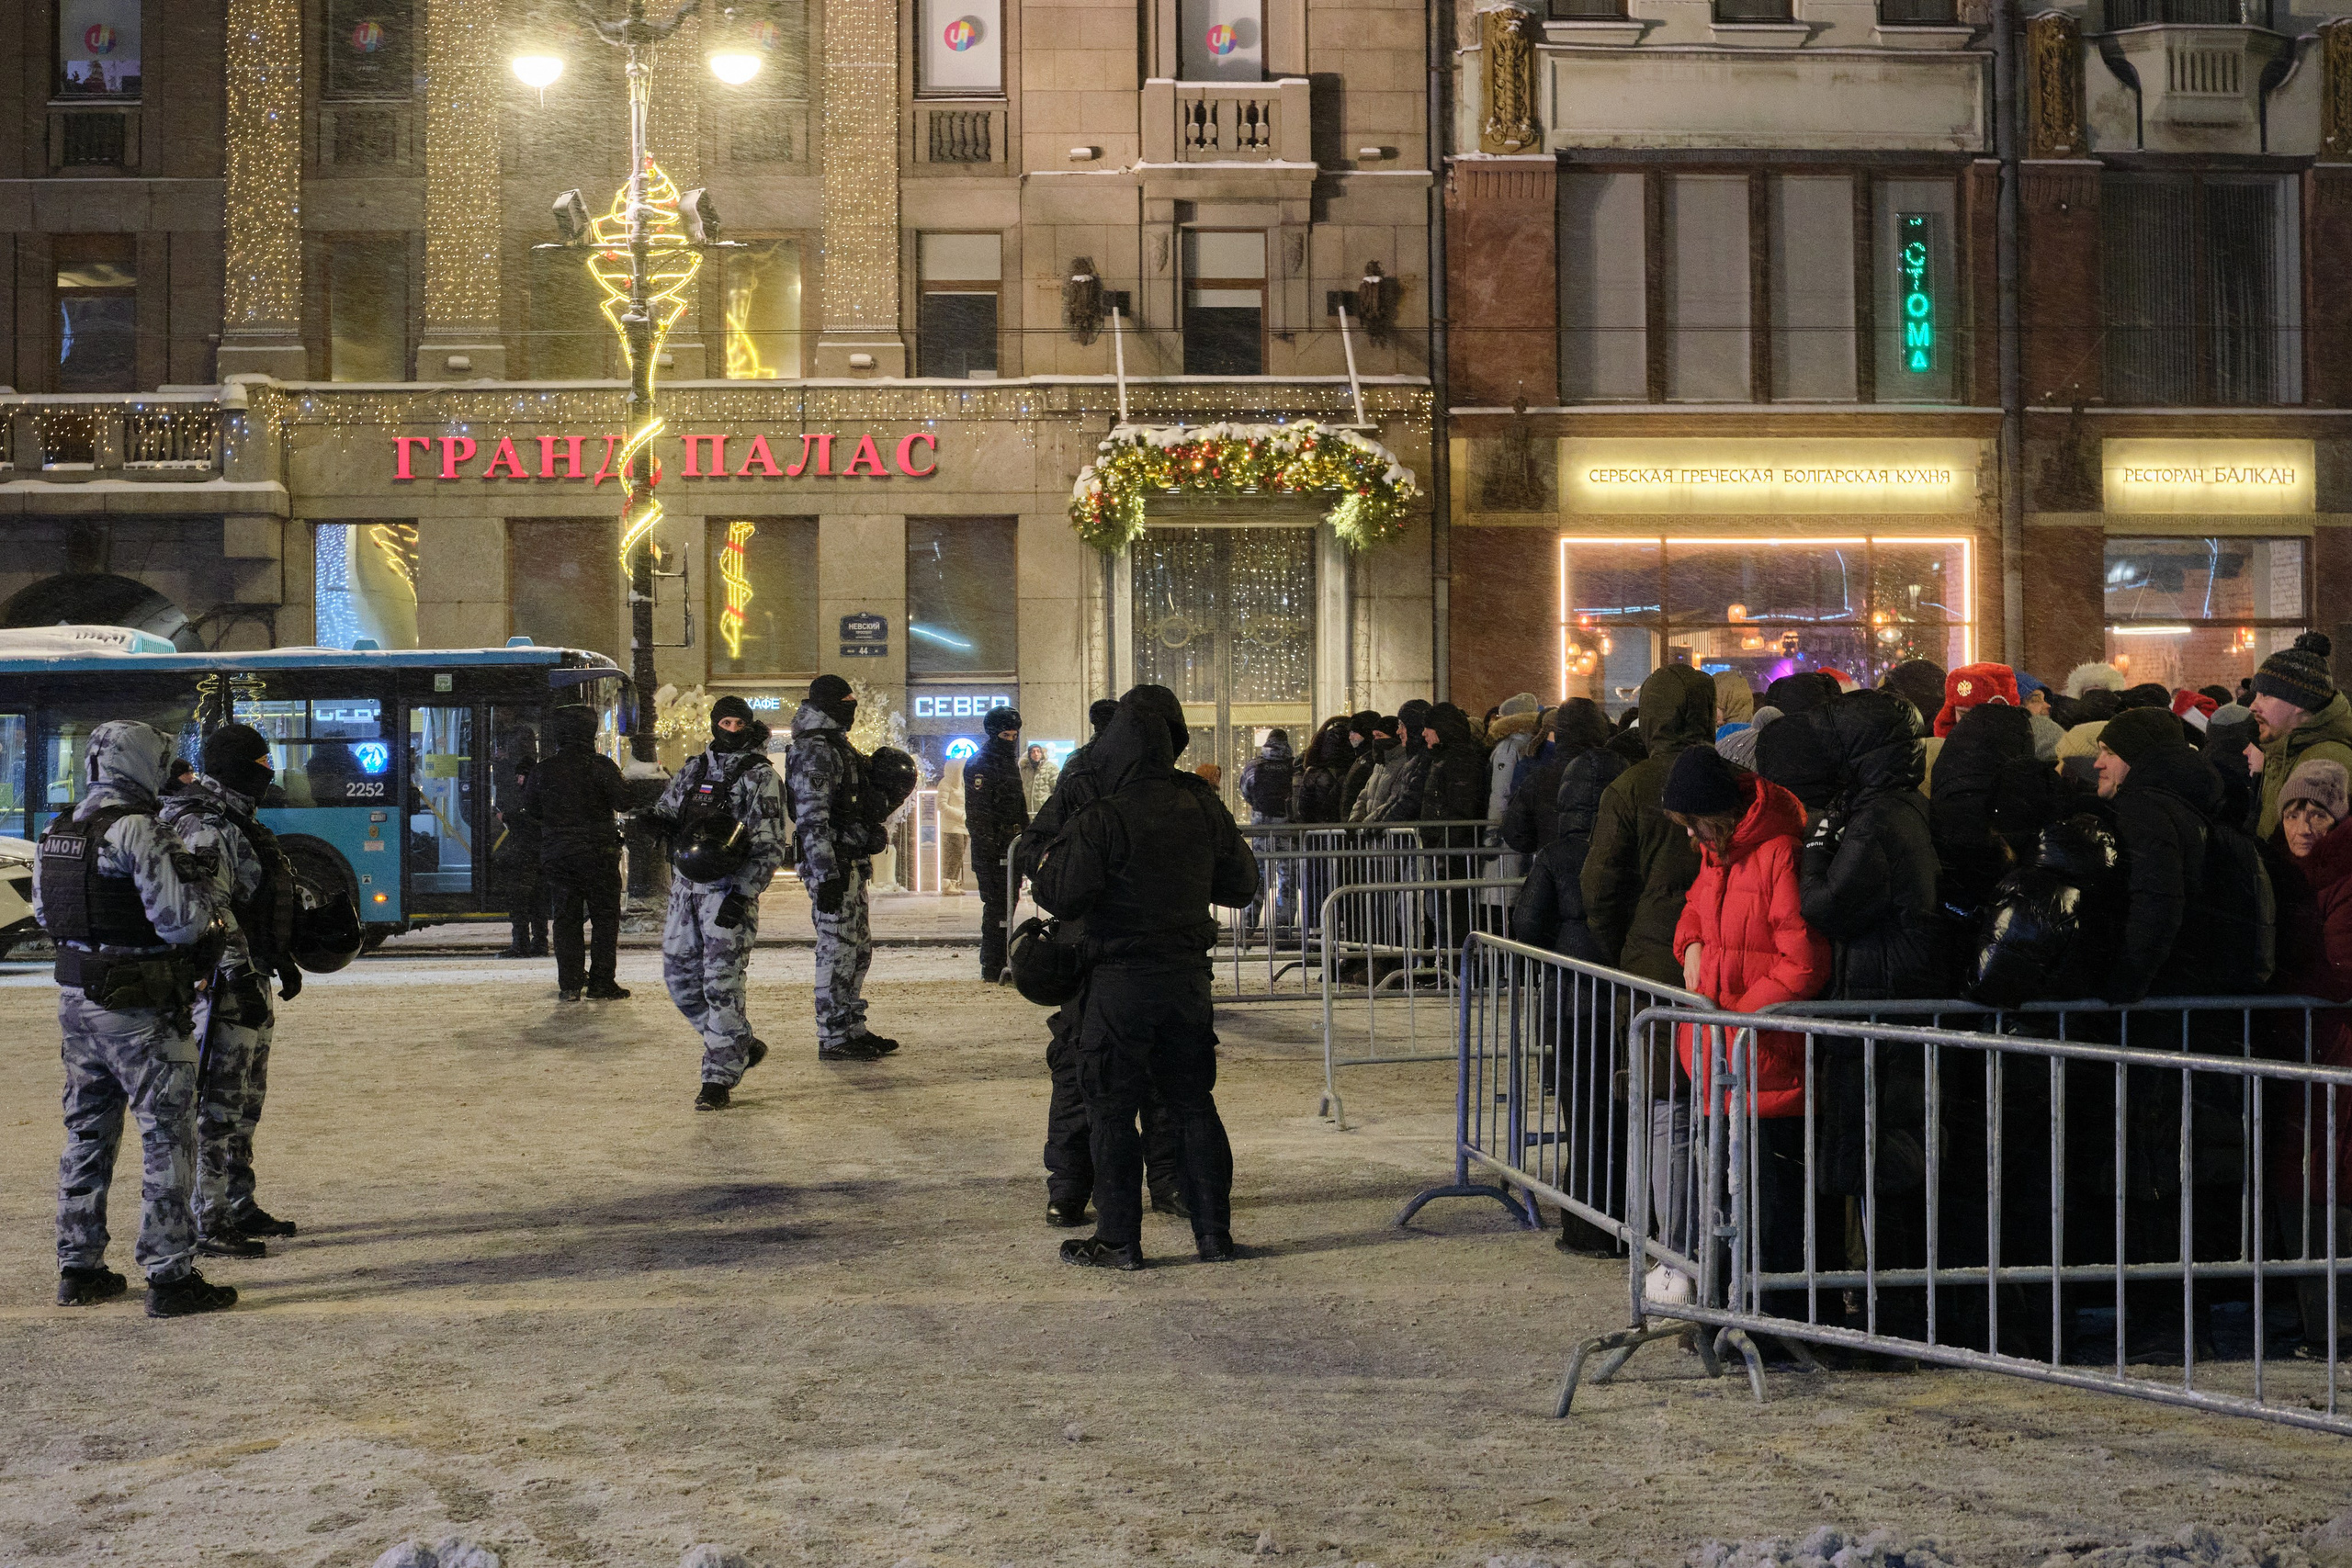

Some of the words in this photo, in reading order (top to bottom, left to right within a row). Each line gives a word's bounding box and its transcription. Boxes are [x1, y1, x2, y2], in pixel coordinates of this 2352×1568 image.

[680, 434, 936, 477] ПАЛАС
[1589, 468, 1673, 483] СЕРБСКАЯ
[1681, 468, 1773, 483] ГРЕЧЕСКАЯ
[1784, 469, 1888, 483] БОЛГАРСКАЯ
[1896, 469, 1950, 483] КУХНЯ
[2125, 468, 2204, 482] РЕСТОРАН
[2214, 467, 2295, 484] БАЛКАН
[848, 621, 880, 630] НЕВСКИЙ
[858, 647, 868, 655] 44
[346, 782, 384, 796] 2252
